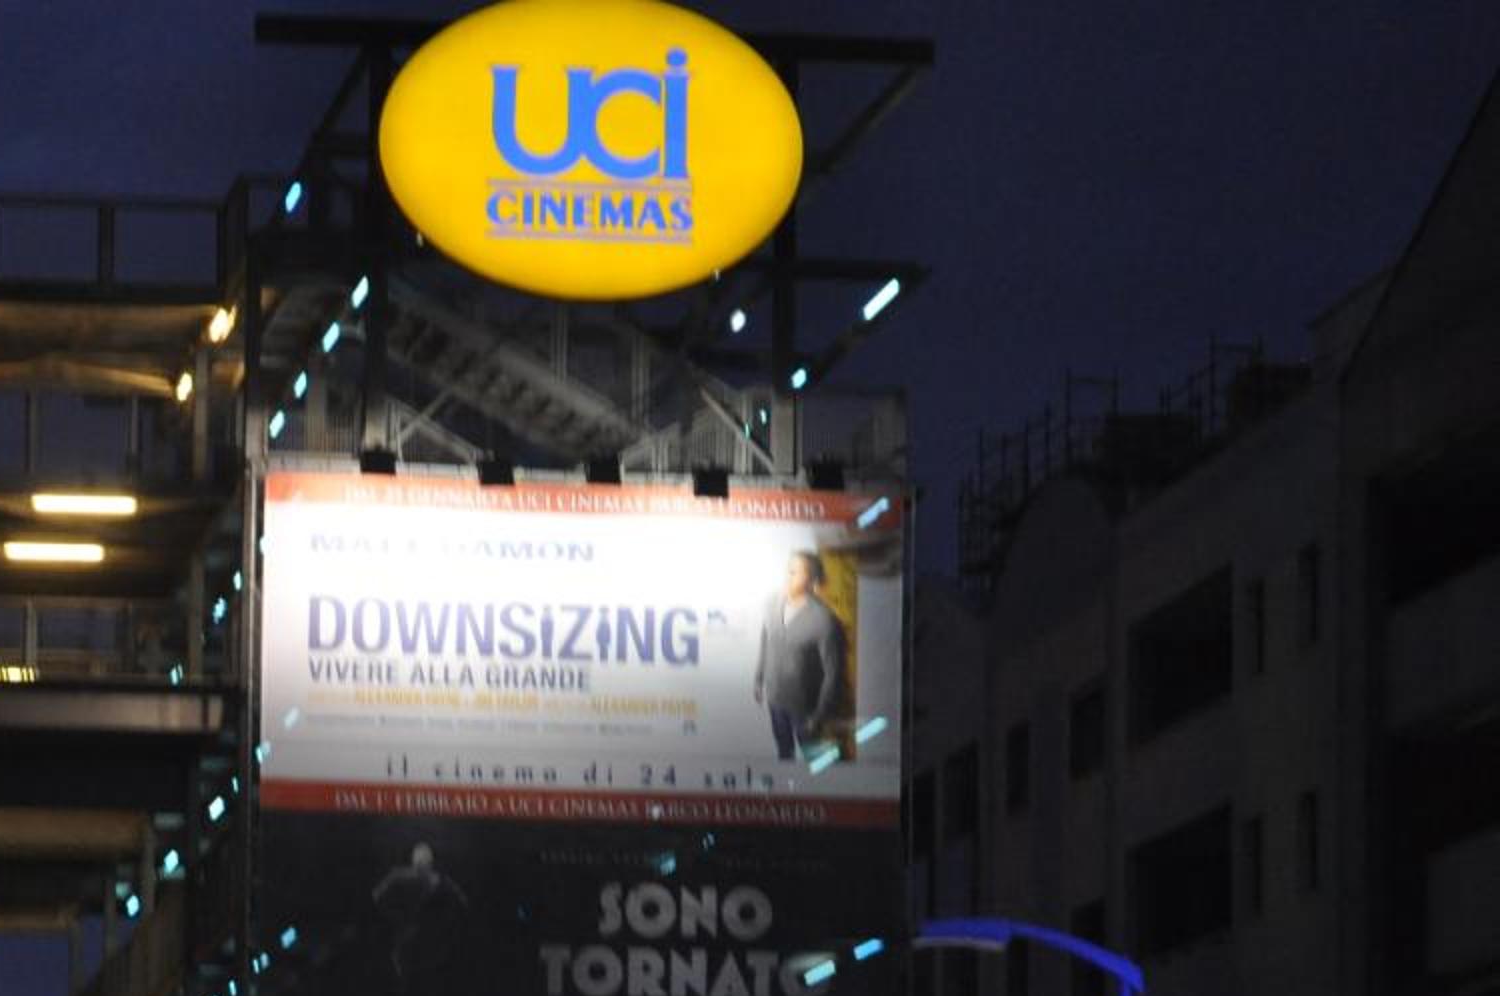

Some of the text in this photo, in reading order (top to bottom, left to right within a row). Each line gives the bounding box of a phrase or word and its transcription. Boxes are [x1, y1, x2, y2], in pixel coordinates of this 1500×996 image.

[485, 190, 695, 233] CINEMAS
[307, 594, 699, 667] DOWNSIZING
[308, 657, 592, 693] VIVERE ALLA GRANDE
[583, 761, 613, 785] di
[640, 764, 676, 786] 24
[395, 790, 489, 815] FEBBRAIO
[549, 796, 638, 820] CINEMAS
[713, 799, 826, 825] LEONARDO
[597, 880, 774, 942] SONO
